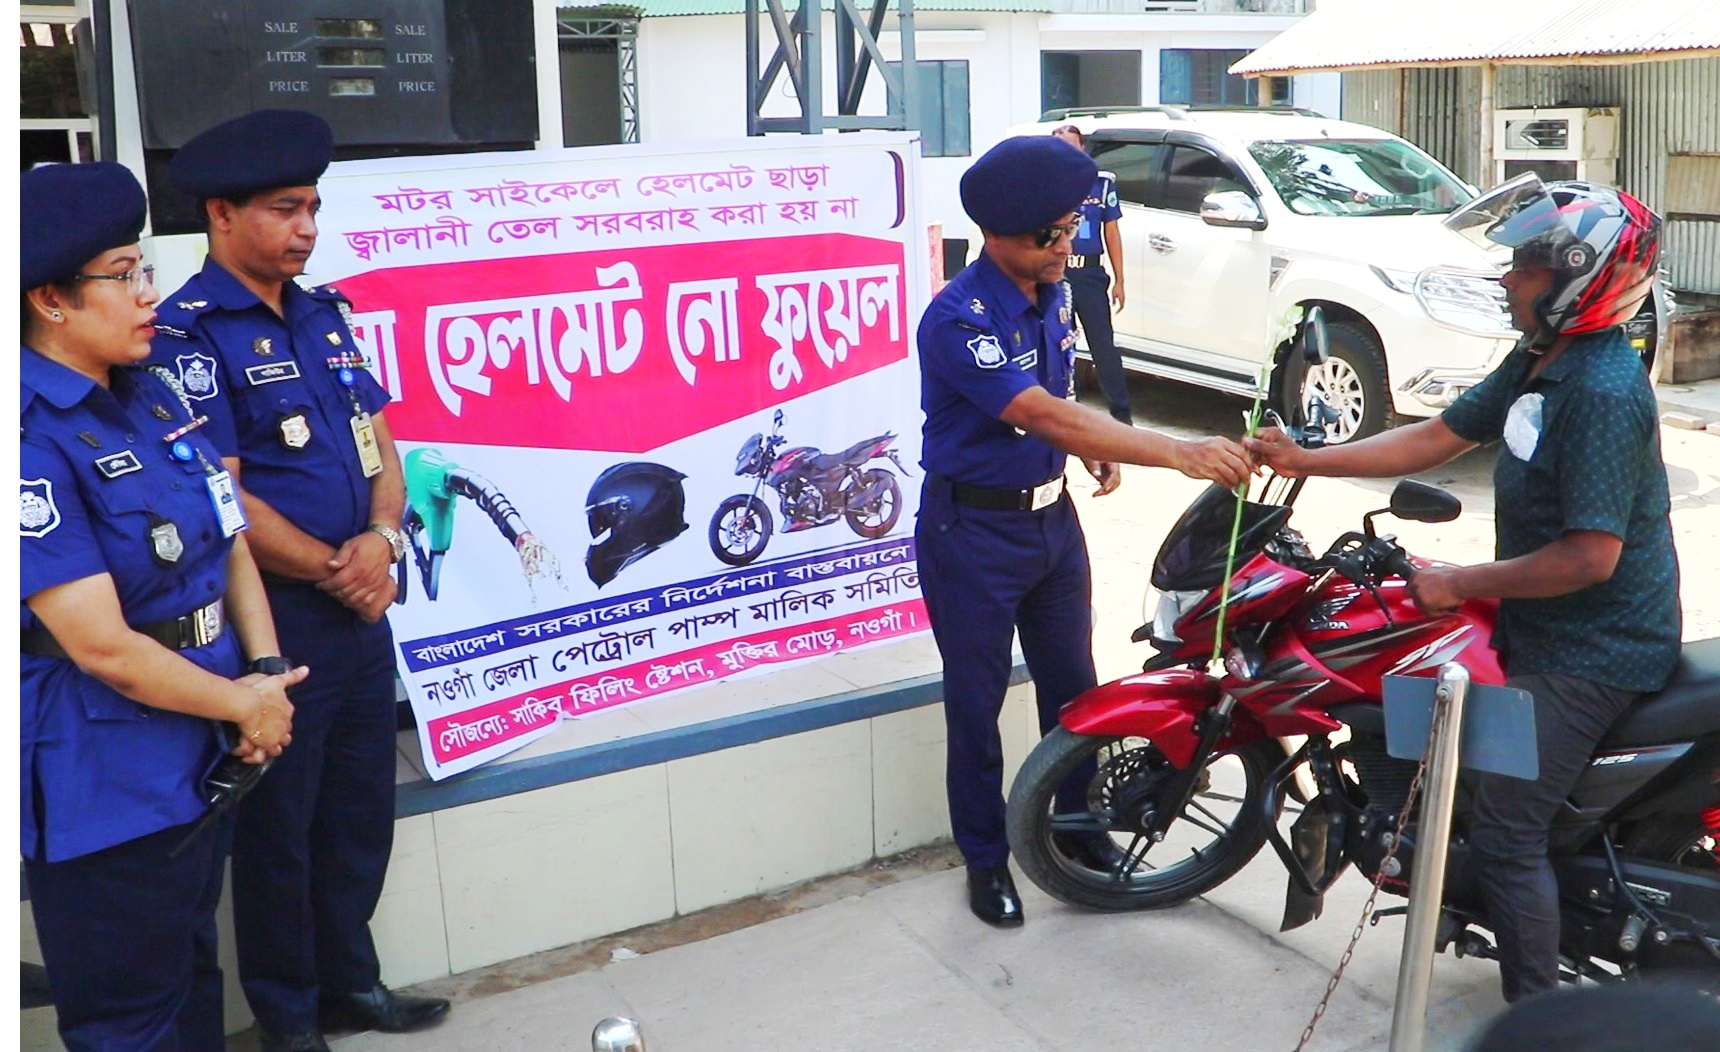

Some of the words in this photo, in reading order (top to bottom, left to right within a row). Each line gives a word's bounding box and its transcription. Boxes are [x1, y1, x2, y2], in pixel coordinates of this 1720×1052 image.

[265, 22, 298, 33] SALE
[395, 25, 426, 35] SALE
[266, 51, 307, 62] LITER
[397, 53, 433, 64] LITER
[269, 81, 309, 92] PRICE
[399, 81, 436, 92] PRICE
[372, 186, 454, 213] মটর
[464, 179, 622, 207] সাইকেলে
[637, 163, 756, 198] হেলমেট
[765, 164, 830, 191] ছাড়া
[342, 215, 473, 261] জ্বালানী
[488, 217, 562, 243] তেল
[572, 207, 701, 237] সরবরাহ
[707, 201, 768, 226] করা
[776, 200, 819, 225] হয়
[827, 196, 860, 219] না
[424, 260, 643, 417] হেলমেট
[666, 277, 741, 387] নো
[755, 263, 900, 391] ফুয়েল
[412, 630, 506, 664] বাংলাদেশ
[514, 597, 653, 638] সরকারের
[660, 570, 778, 608] নির্দেশনা
[784, 545, 910, 580] বাস্তবায়নে
[422, 667, 476, 707] নওগাঁ
[483, 655, 539, 692] জেলা
[552, 627, 657, 673] পেট্রোল
[668, 607, 740, 640] পাম্প
[748, 587, 836, 623] মালিক
[844, 566, 920, 602] সমিতি
[568, 676, 642, 709] ফিলিং
[645, 658, 715, 688] ষ্টেশন,
[716, 639, 778, 671] মুক্তির
[785, 628, 844, 651] মোড়,
[1591, 753, 1638, 767] 125
